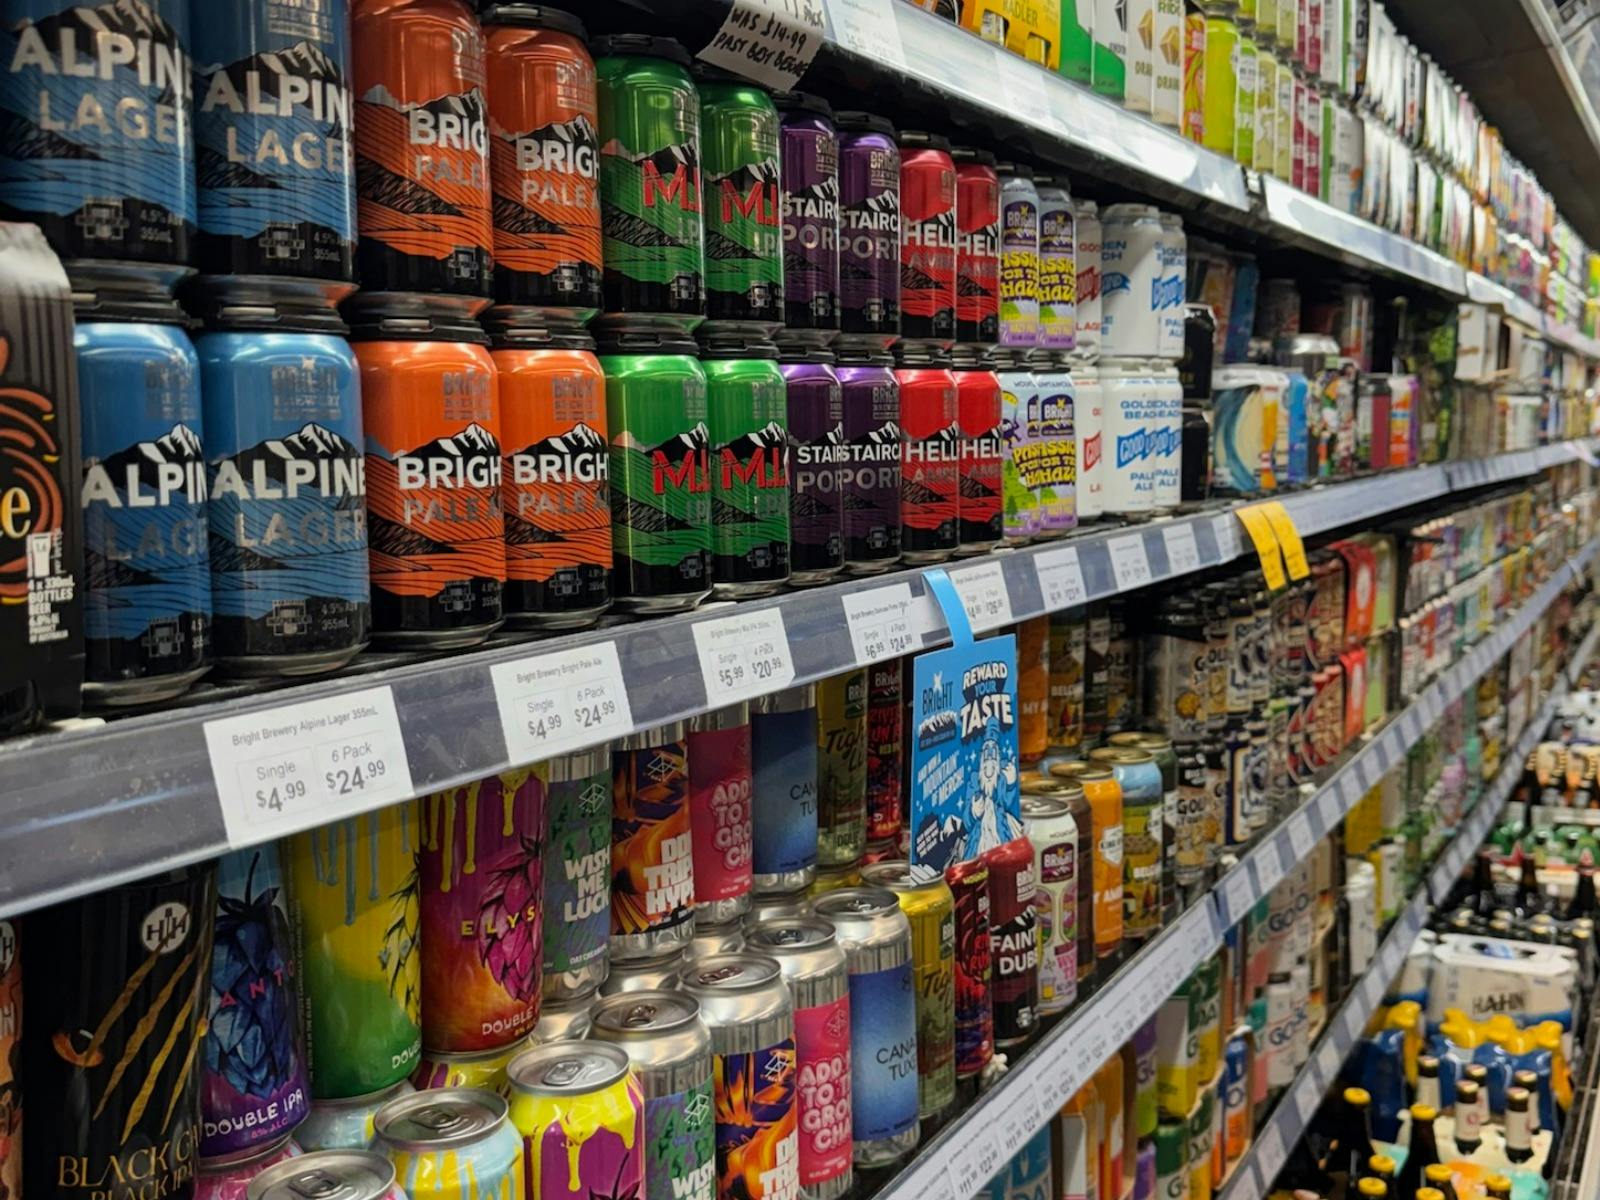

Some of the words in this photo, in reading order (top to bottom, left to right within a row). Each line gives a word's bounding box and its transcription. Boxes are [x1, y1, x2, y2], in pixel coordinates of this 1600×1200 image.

[713, 32, 748, 53] PAST
[731, 8, 760, 31] WAS
[761, 12, 807, 55] $14.99
[10, 27, 192, 97] ALPIN
[203, 70, 354, 131] ALPIN
[28, 588, 74, 604] BOTTLES
[516, 671, 536, 683] Bright
[537, 667, 560, 679] Brewery
[561, 662, 579, 674] Bright
[719, 665, 744, 687] $5.99
[751, 657, 782, 679] $20.99
[962, 662, 1008, 692] REWARD
[577, 690, 583, 702] 6
[585, 686, 605, 700] Pack
[922, 681, 954, 716] BRIGHT
[973, 680, 997, 697] YOUR
[527, 698, 554, 714] Single
[574, 700, 616, 728] $24.99
[960, 692, 1014, 740] TASTE
[232, 732, 261, 747] Bright
[262, 724, 298, 742] Brewery
[300, 718, 326, 732] Alpine
[327, 711, 350, 726] Lager
[352, 705, 379, 720] 355mL
[527, 713, 562, 740] $4.99
[331, 749, 340, 763] 6
[343, 741, 373, 760] Pack
[256, 760, 297, 781] Single
[325, 758, 386, 796] $24.99
[255, 780, 306, 813] $4.99
[564, 844, 610, 881] WISH
[578, 868, 605, 900] ME
[563, 885, 610, 923] LUCK
[482, 1005, 535, 1037] DOUBLE
[204, 1101, 279, 1138] DOUBLE
[282, 1087, 303, 1113] IPA
[58, 1141, 171, 1188] BLACK
